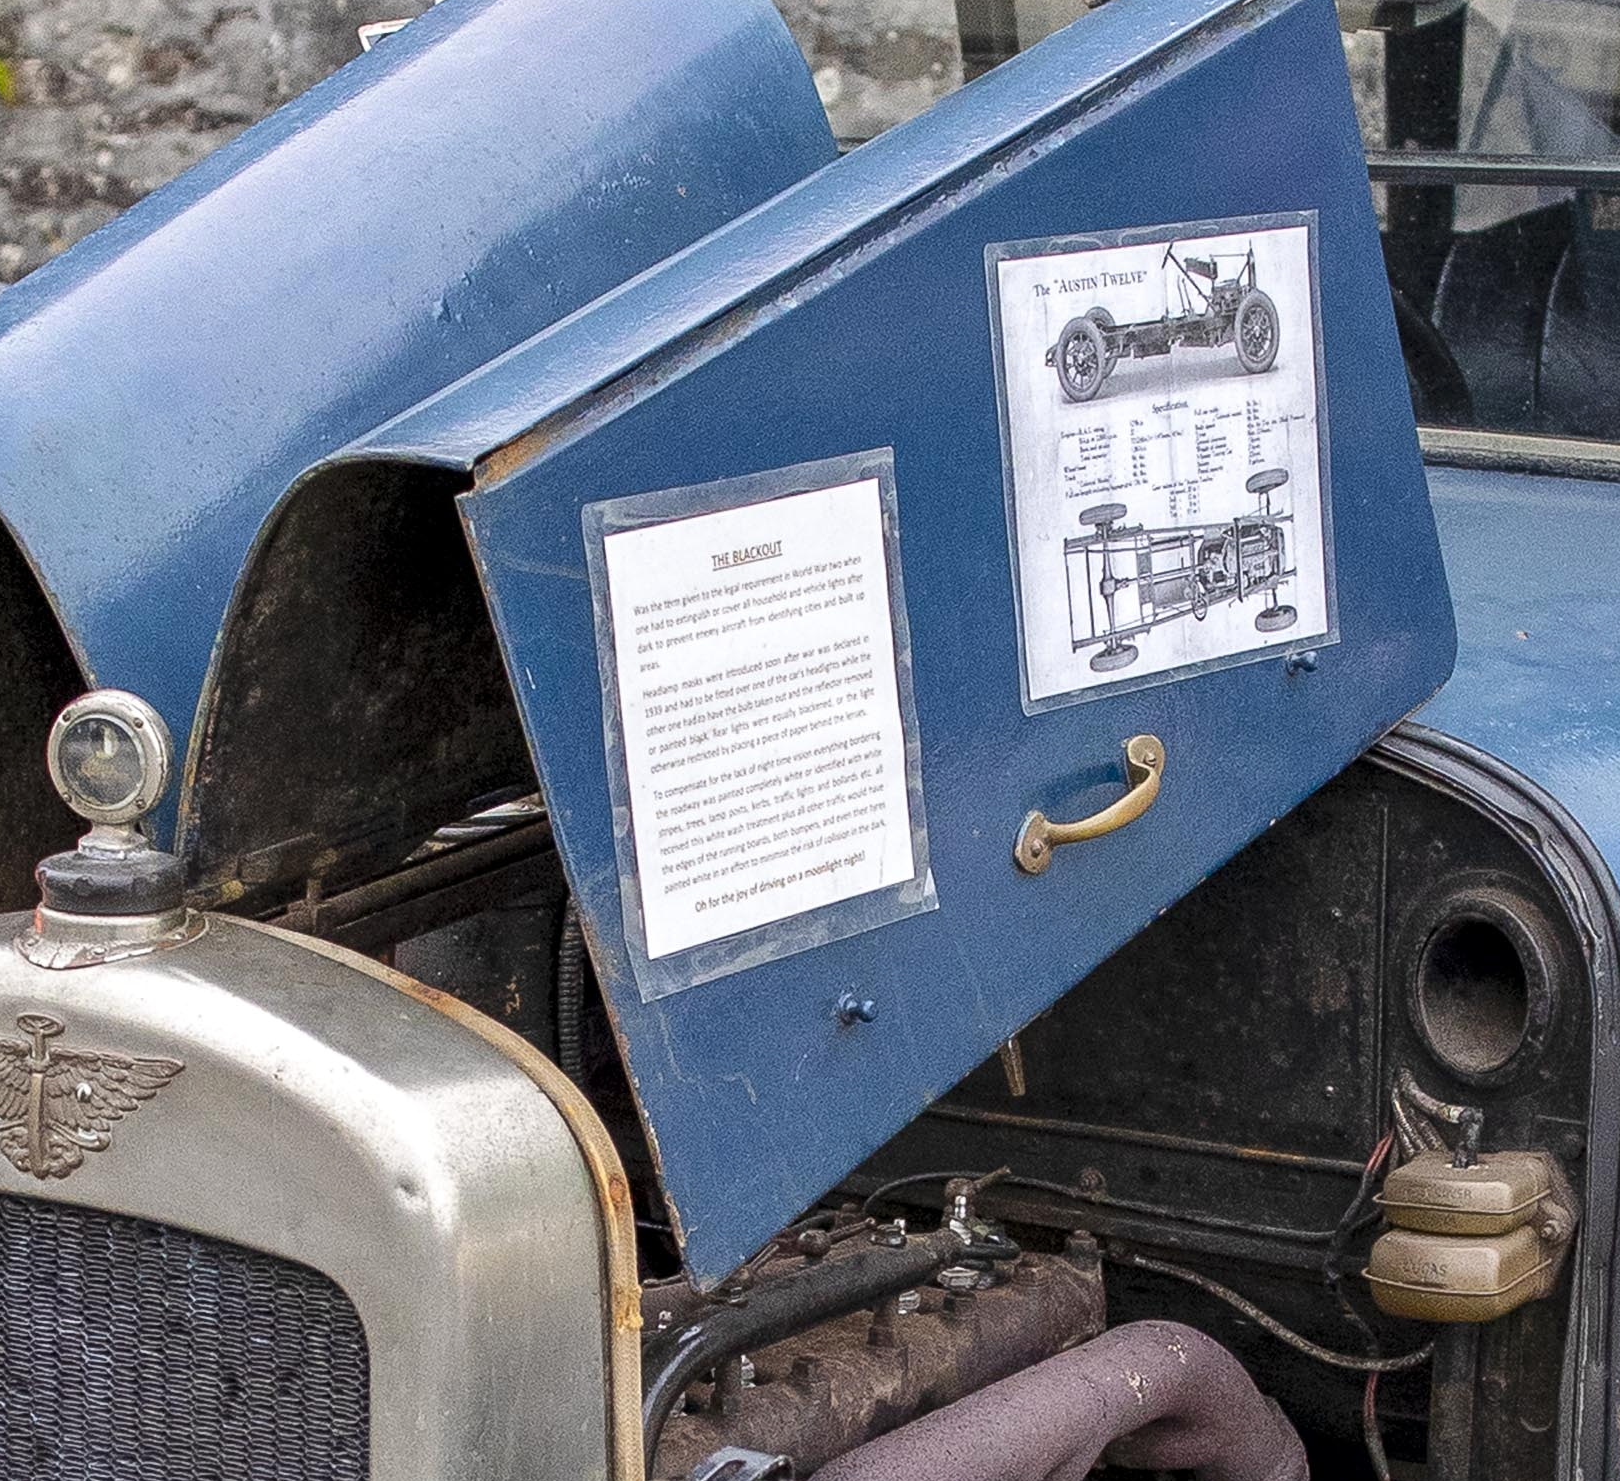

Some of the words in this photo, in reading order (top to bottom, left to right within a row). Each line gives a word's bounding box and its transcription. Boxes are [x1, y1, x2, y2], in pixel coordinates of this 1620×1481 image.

[1033, 283, 1051, 298] The
[711, 551, 730, 567] THE
[732, 539, 782, 563] BLACKOUT
[694, 900, 707, 913] Oh
[707, 896, 720, 908] for
[721, 893, 734, 904] the
[736, 889, 748, 902] joy
[749, 882, 758, 895] of
[758, 877, 786, 893] driving
[786, 873, 797, 884] on
[804, 858, 842, 878] moonlight
